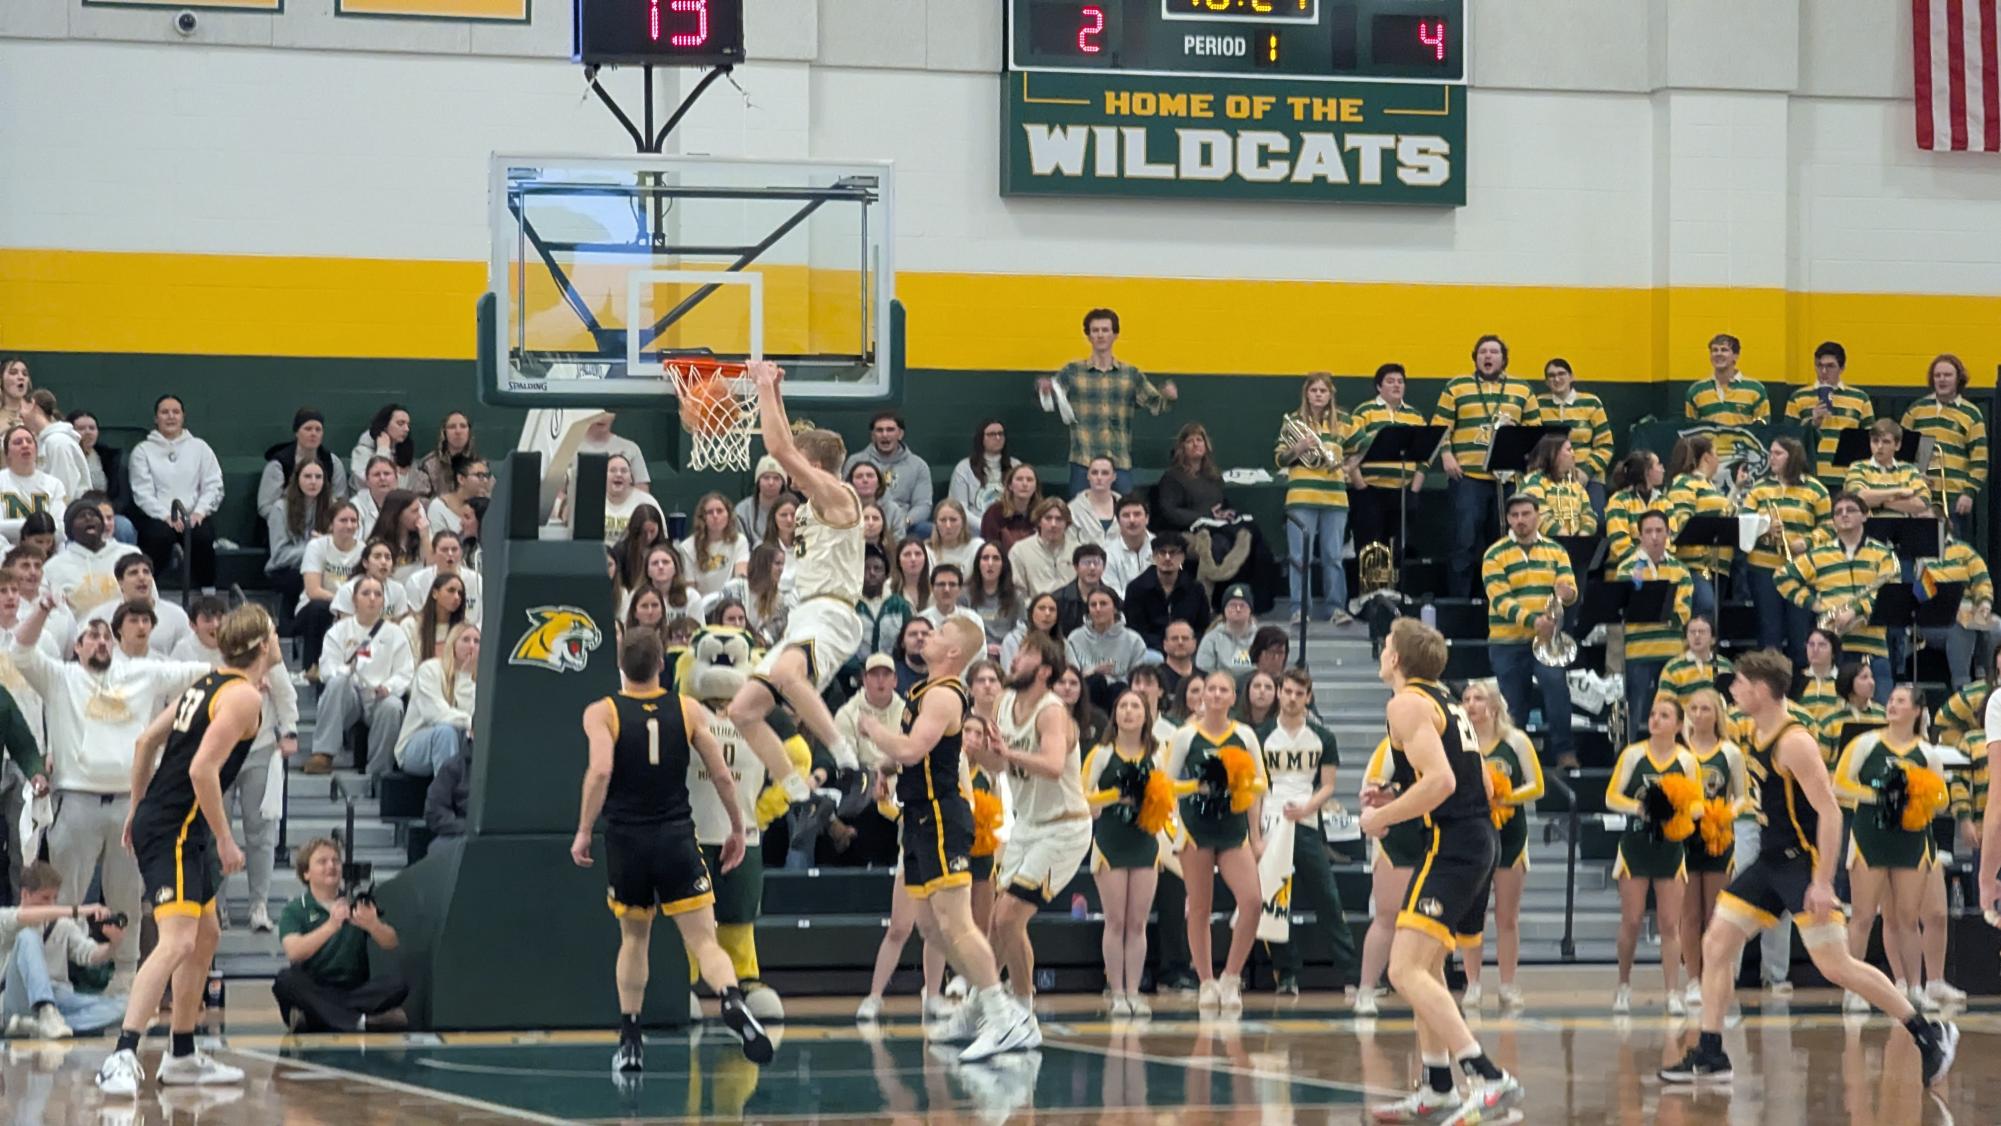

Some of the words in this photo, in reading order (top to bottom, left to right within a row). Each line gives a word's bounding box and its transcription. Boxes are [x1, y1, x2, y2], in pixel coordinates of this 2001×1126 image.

[1079, 8, 1103, 52] 2
[1184, 35, 1246, 56] PERIOD
[1419, 22, 1443, 60] 4
[1269, 34, 1277, 62] 1
[1104, 90, 1214, 118] HOME
[1226, 95, 1276, 119] OF
[1287, 97, 1364, 122] THE
[1022, 123, 1450, 187] WILDCATS
[508, 380, 547, 391] SPALDING
[646, 718, 660, 765] 1
[1268, 750, 1322, 770] NMU
